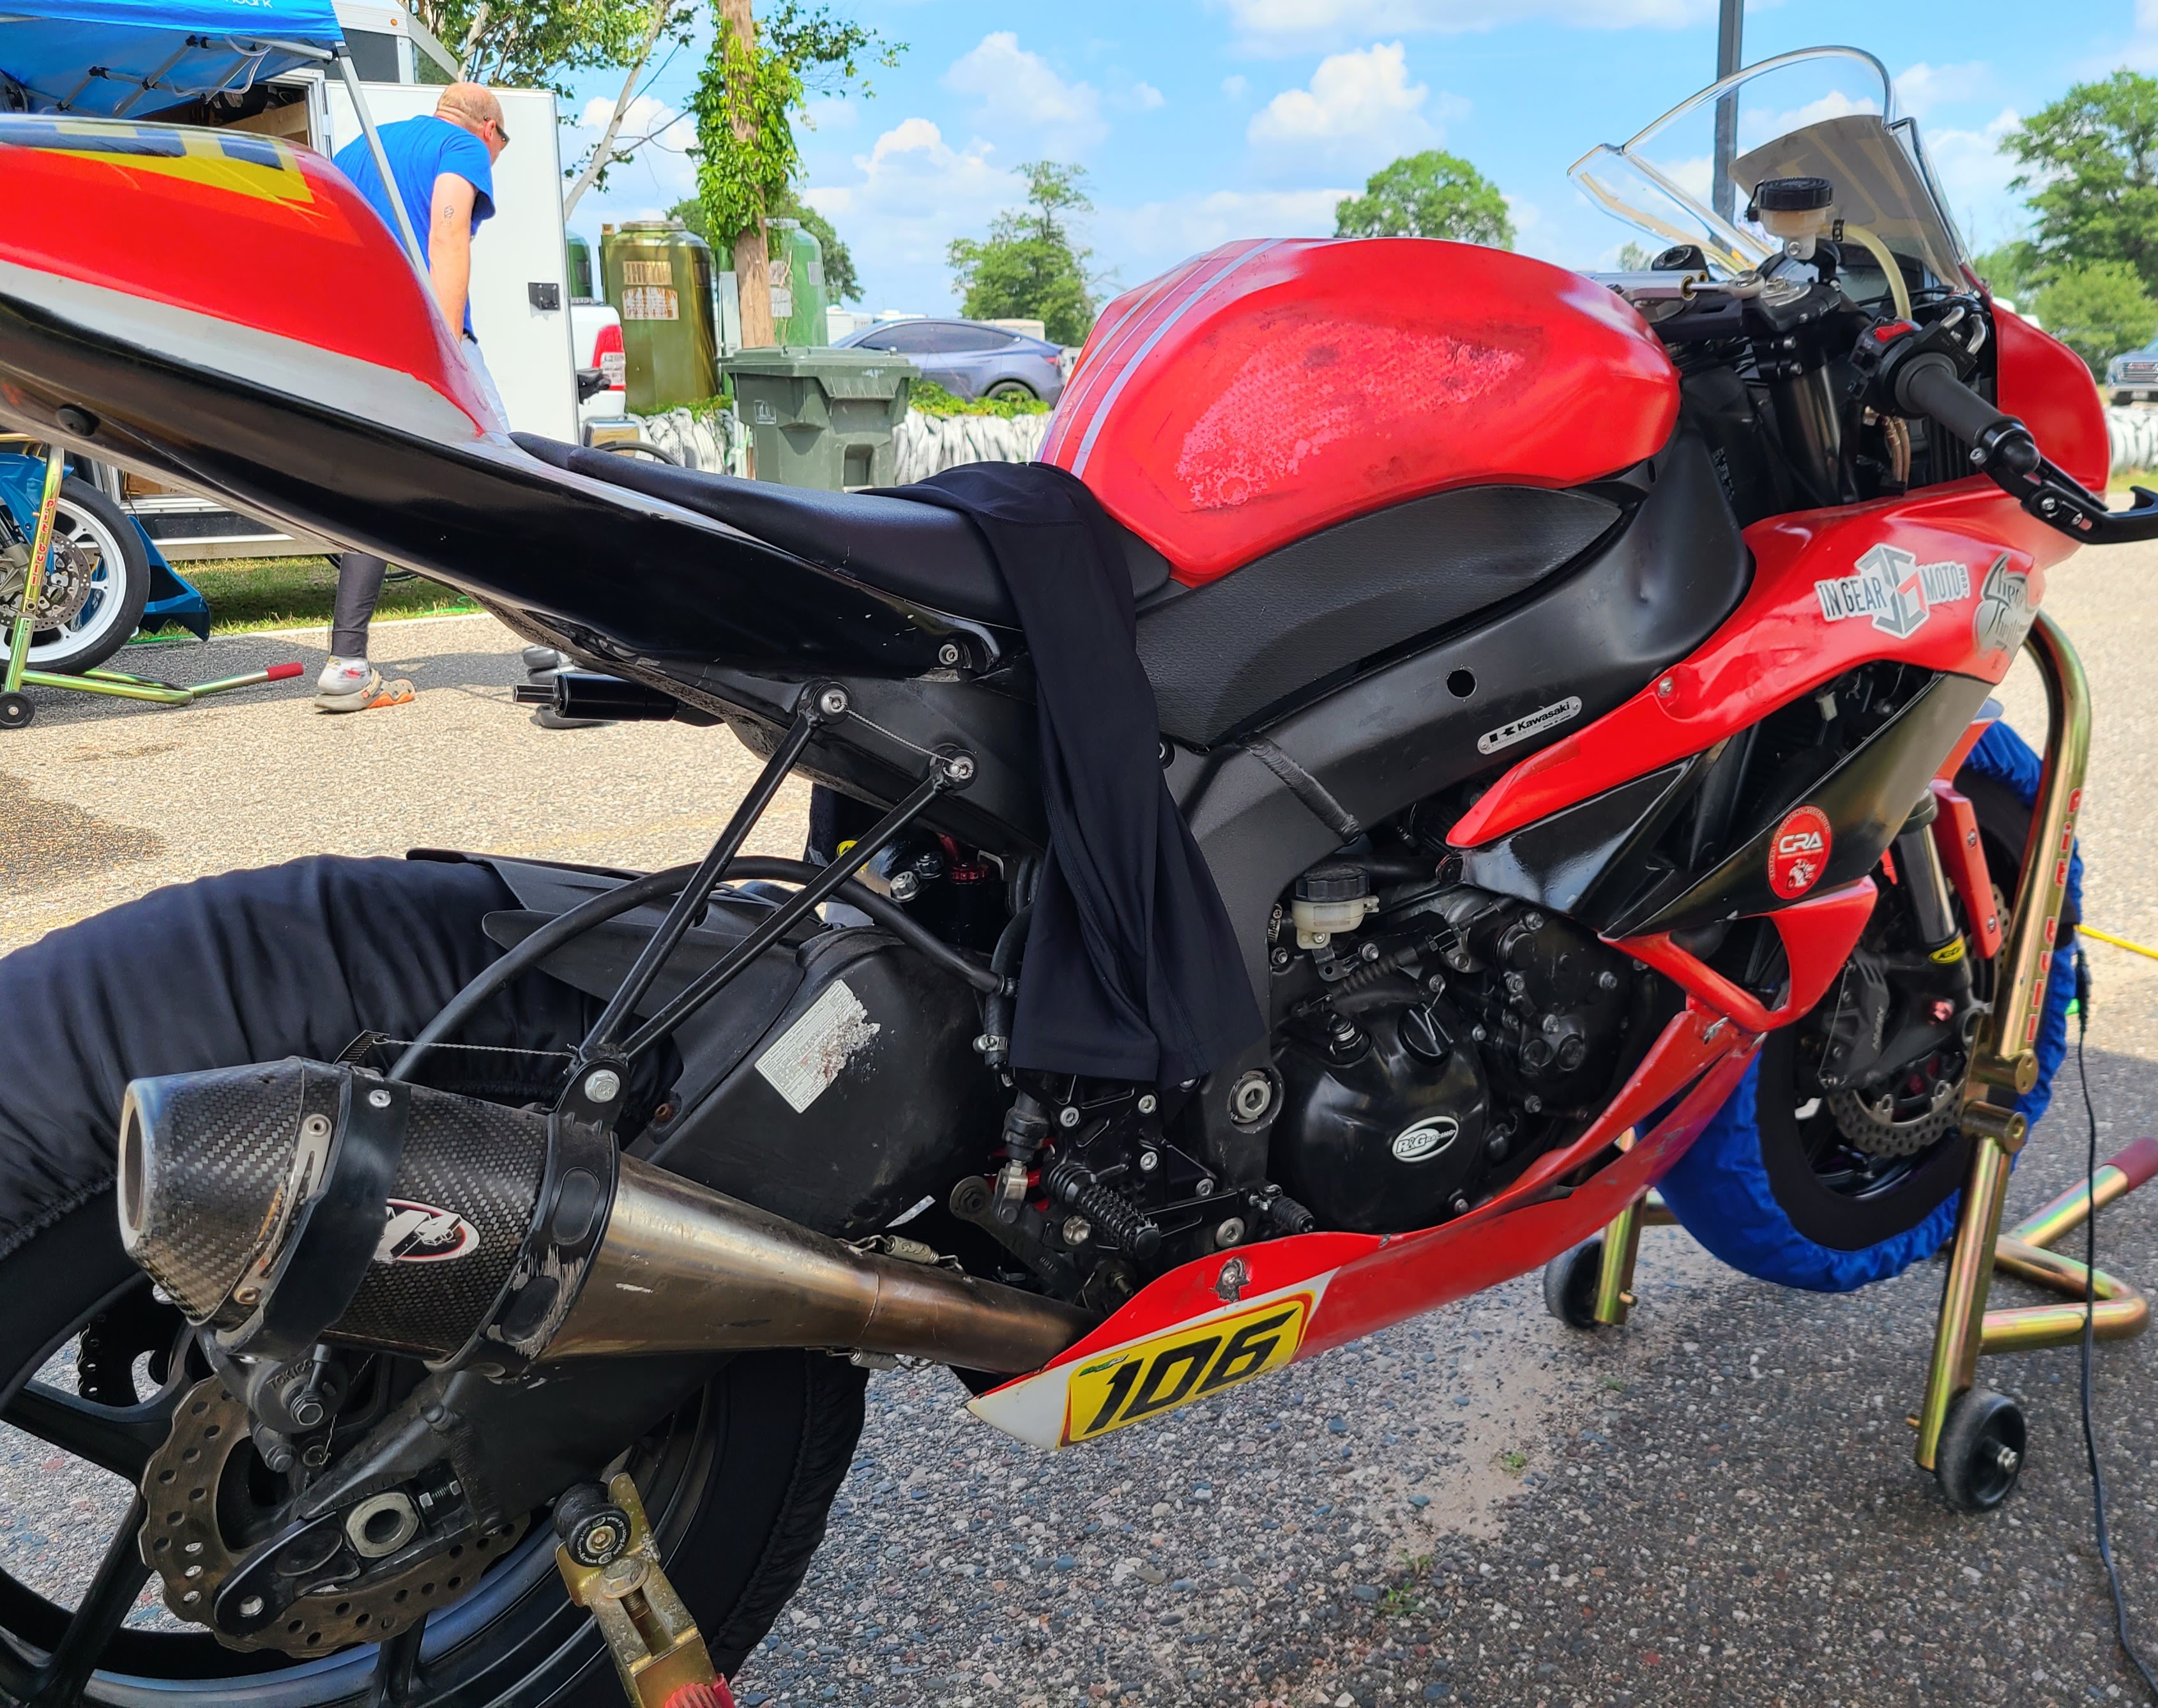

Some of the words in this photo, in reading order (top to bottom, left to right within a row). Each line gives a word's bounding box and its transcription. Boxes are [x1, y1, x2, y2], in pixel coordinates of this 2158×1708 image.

[42, 499, 55, 533] pit
[31, 542, 47, 585] bull
[1818, 582, 1843, 618] IN
[1841, 577, 1887, 613] GEAR
[1921, 565, 1961, 601] MOTO
[1517, 701, 1570, 731] Kawasaki
[1779, 830, 1823, 853] CRA
[1396, 1132, 1427, 1154] R&G
[1426, 1129, 1456, 1143] RACING
[1083, 1306, 1300, 1435] 106
